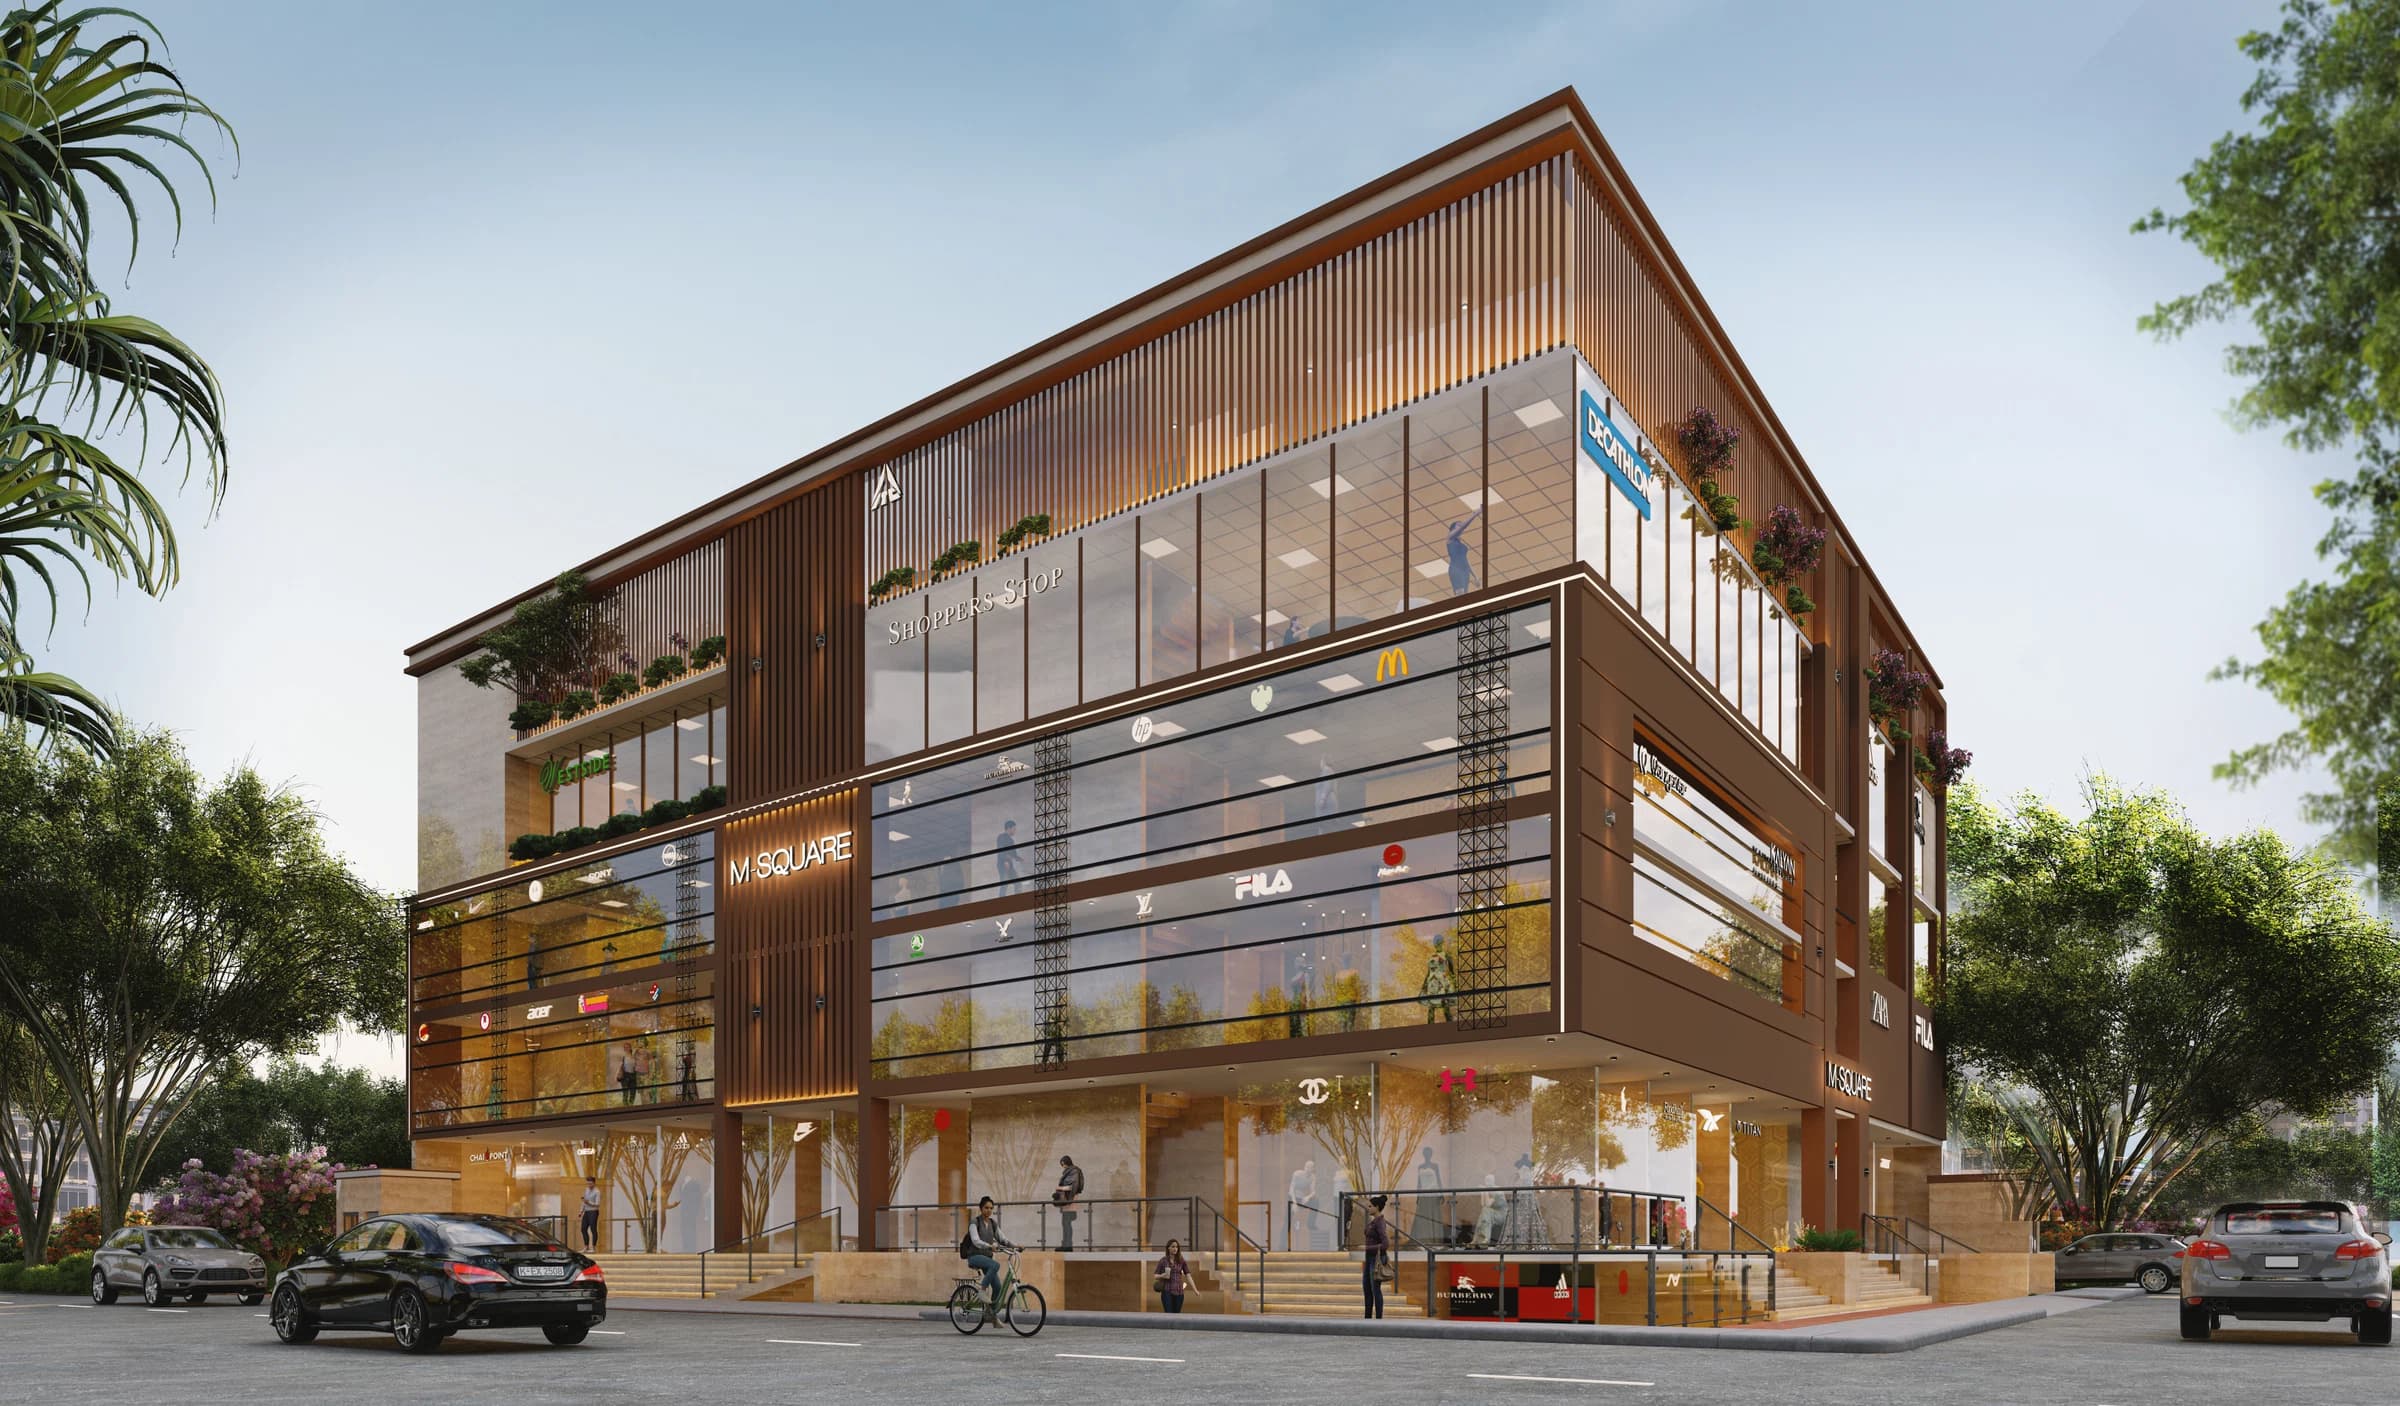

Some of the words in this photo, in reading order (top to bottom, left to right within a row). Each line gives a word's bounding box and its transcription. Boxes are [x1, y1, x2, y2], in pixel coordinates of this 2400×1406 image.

[1587, 406, 1655, 504] DECATHLON
[588, 868, 613, 881] SONY
[730, 831, 853, 885] M-SQUARE
[1235, 868, 1293, 901] FILA
[527, 1005, 553, 1020] acer
[1871, 990, 1890, 1030] ZARA
[1915, 1014, 1934, 1052] FILA
[1826, 1060, 1873, 1102] M-SQUARE
[469, 1153, 485, 1162] CHAI
[489, 1151, 508, 1161] POINT
[1436, 1291, 1494, 1299] BURBERRY
